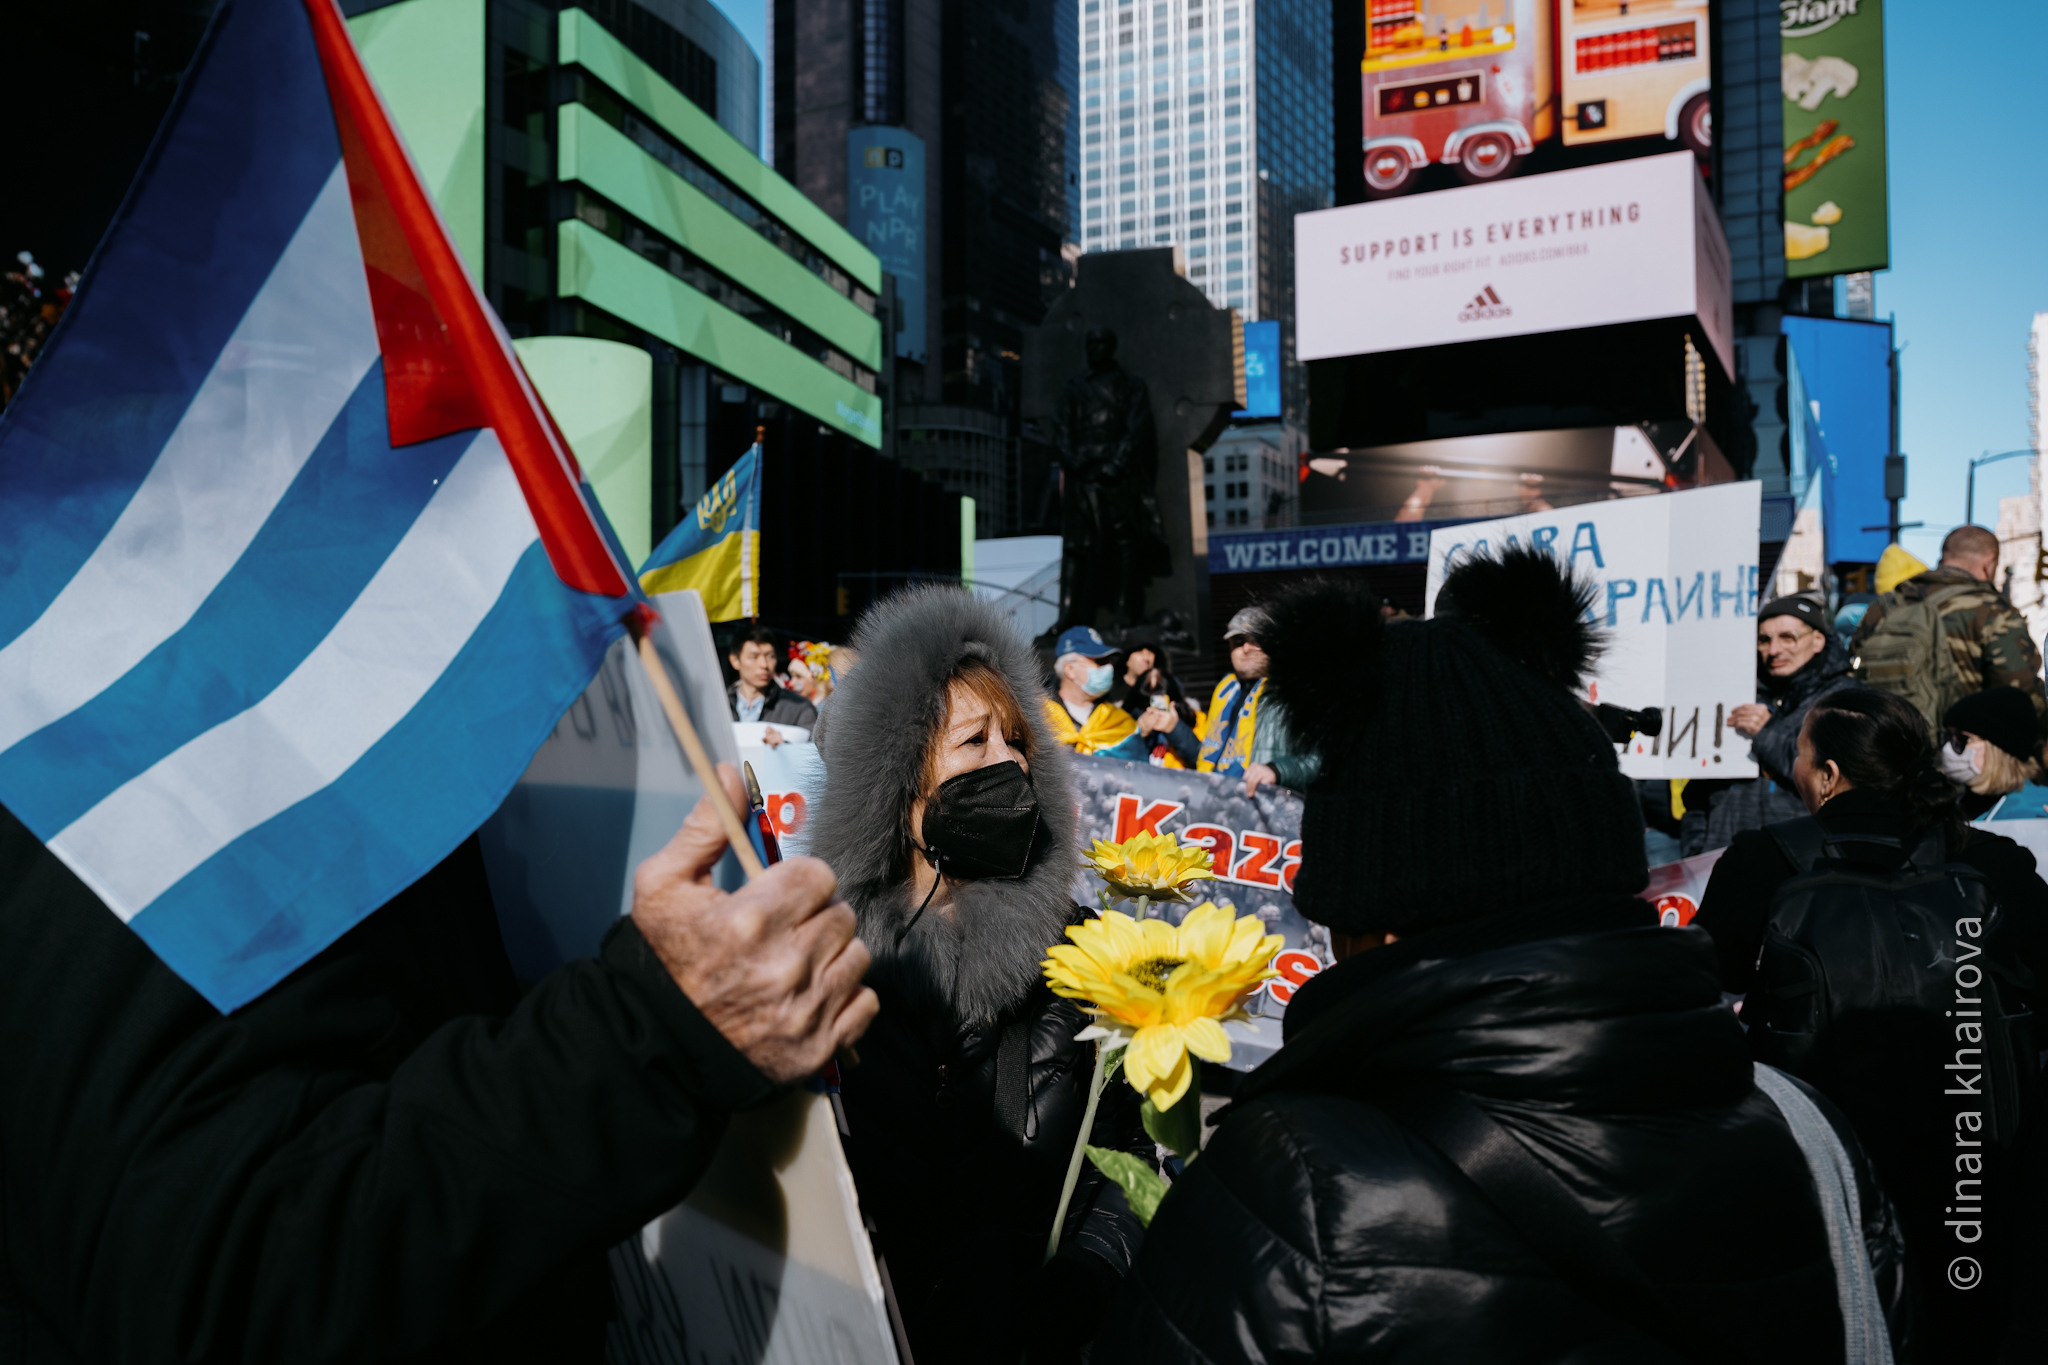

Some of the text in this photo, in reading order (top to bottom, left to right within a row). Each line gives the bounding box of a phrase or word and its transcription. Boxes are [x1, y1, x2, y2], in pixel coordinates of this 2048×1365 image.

[1340, 202, 1641, 265] SUPPORT IS EVERYTHING
[1458, 306, 1512, 323] adidas
[1223, 533, 1399, 570] WELCOME
